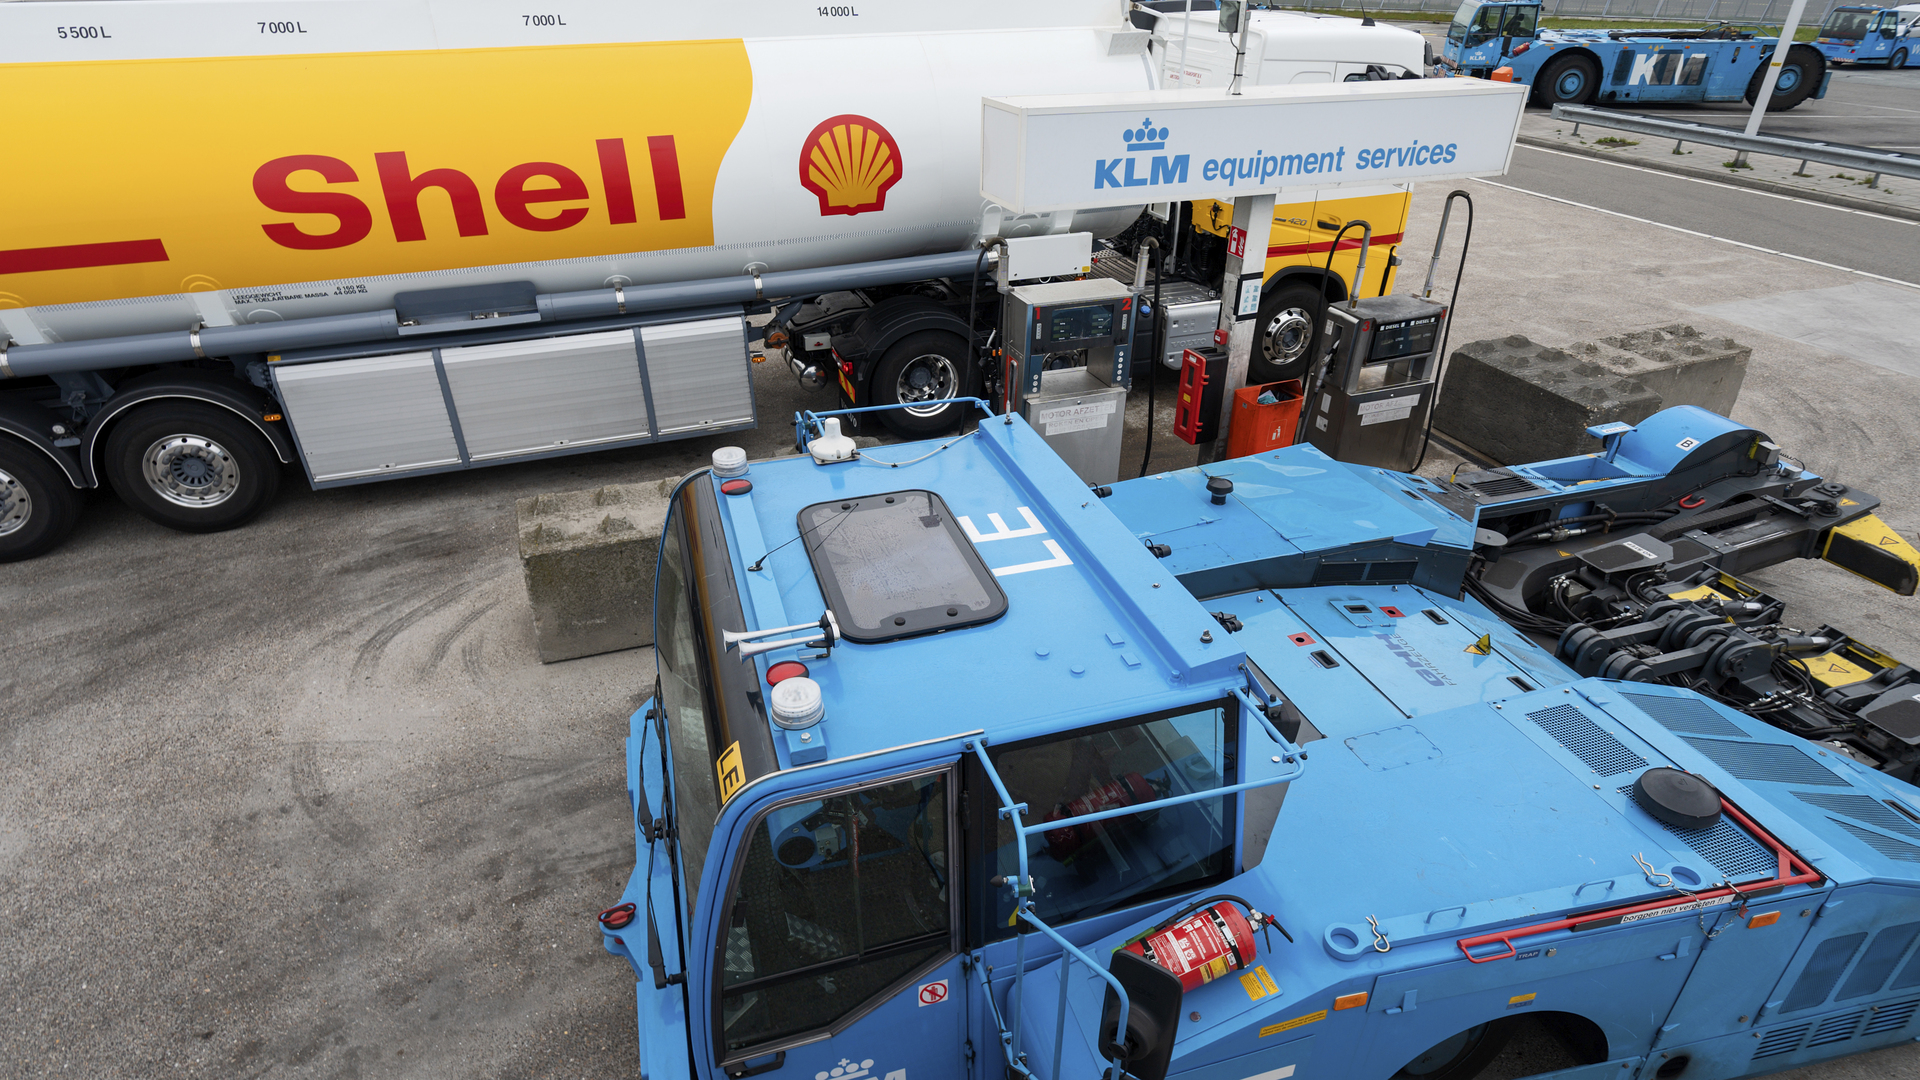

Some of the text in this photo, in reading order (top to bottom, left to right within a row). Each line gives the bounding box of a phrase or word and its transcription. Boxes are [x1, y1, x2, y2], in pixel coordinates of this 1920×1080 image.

[1094, 139, 1458, 190] KLM equipment services
[252, 134, 687, 251] Shell
[1288, 217, 1308, 226] 420
[1121, 298, 1132, 311] 2
[1035, 307, 1040, 320] 1
[1362, 321, 1370, 332] 3
[1041, 409, 1071, 420] MOTOR
[1680, 439, 1694, 448] B
[956, 506, 1074, 577] LE
[1374, 633, 1445, 687] GHH
[1390, 632, 1457, 686] FAHRZEUGE
[720, 746, 740, 797] LE
[1623, 910, 1659, 922] borgpen
[1660, 905, 1677, 915] niet
[1517, 950, 1539, 960] TRAP
